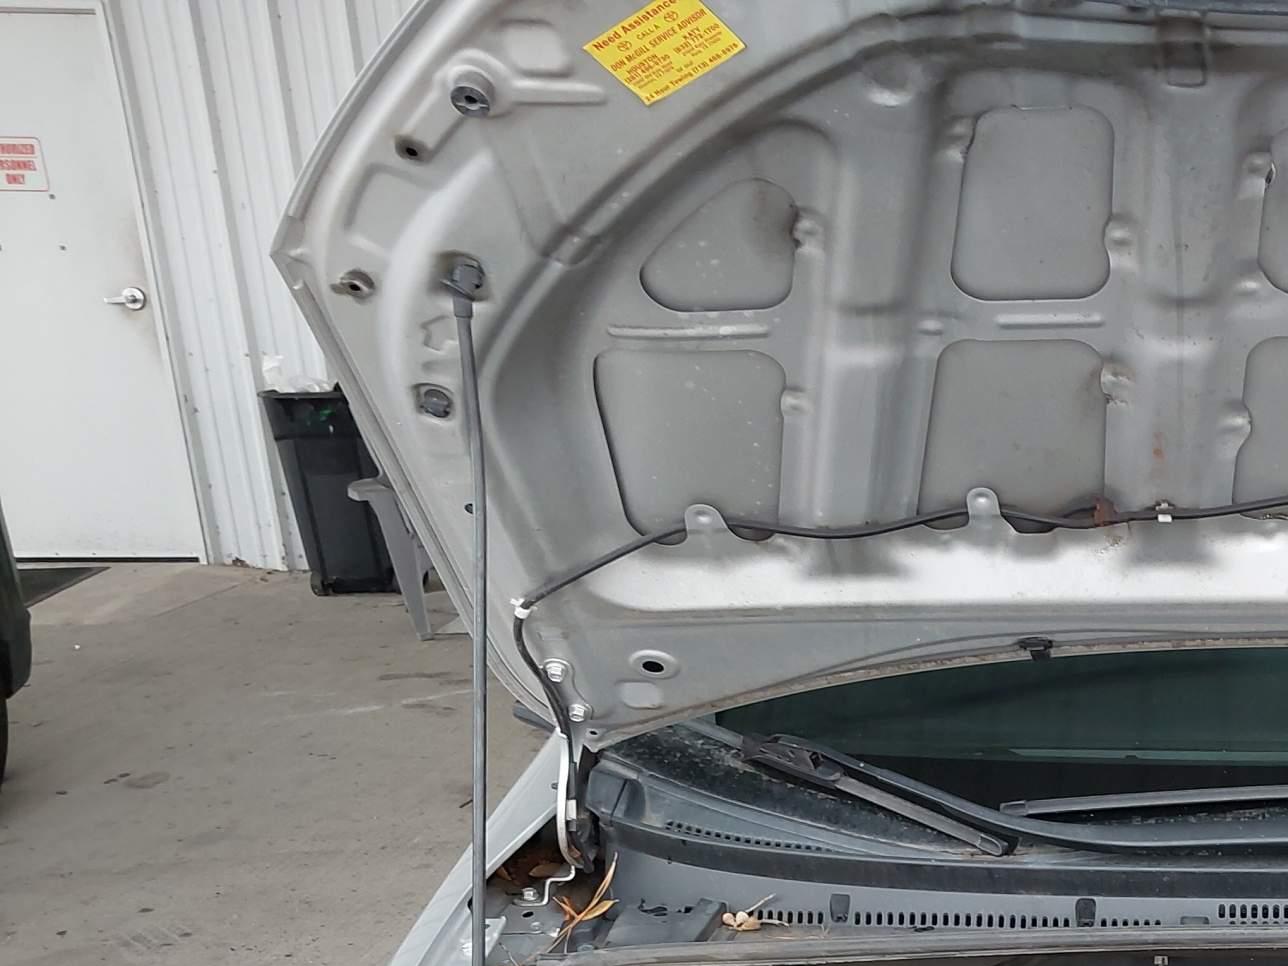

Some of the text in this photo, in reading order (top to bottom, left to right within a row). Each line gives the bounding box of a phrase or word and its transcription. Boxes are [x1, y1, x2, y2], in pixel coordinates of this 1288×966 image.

[592, 28, 622, 52] Need
[648, 28, 677, 49] SERVICE
[678, 8, 707, 32] ADVISOR
